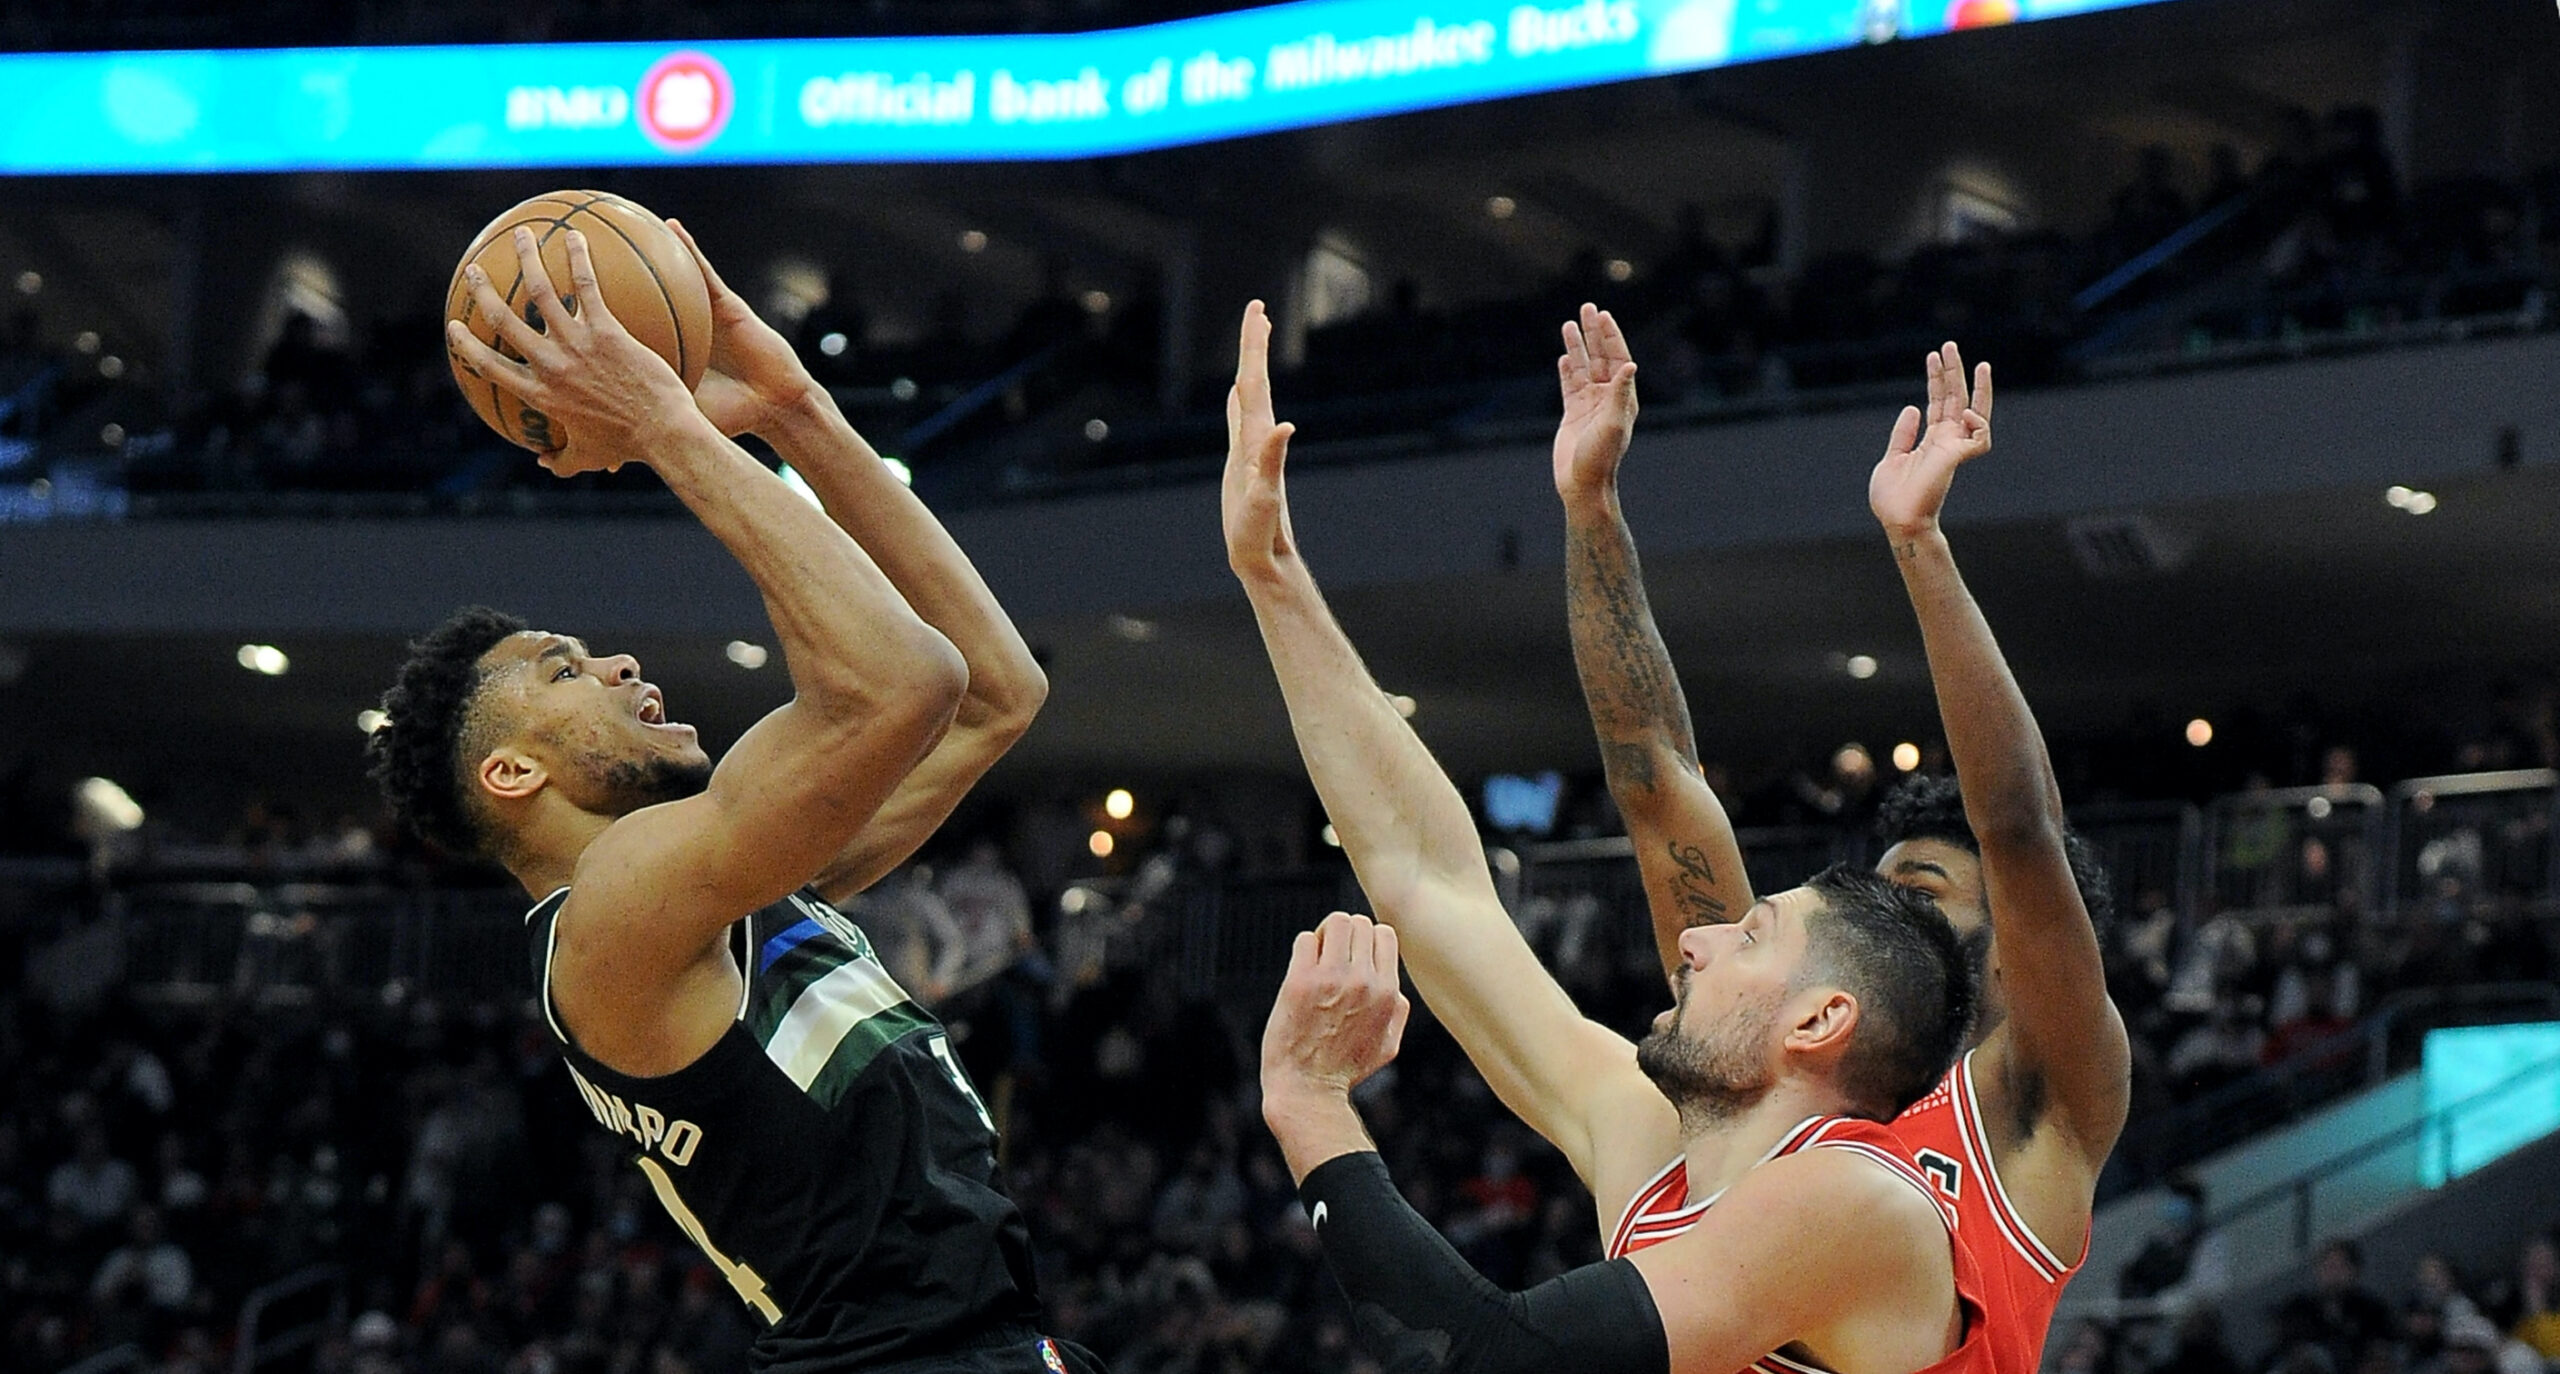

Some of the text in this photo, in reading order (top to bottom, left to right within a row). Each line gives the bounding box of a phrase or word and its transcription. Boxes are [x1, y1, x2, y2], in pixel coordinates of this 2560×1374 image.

[800, 2, 1639, 127] Official bank of the Milwaukee Bucks
